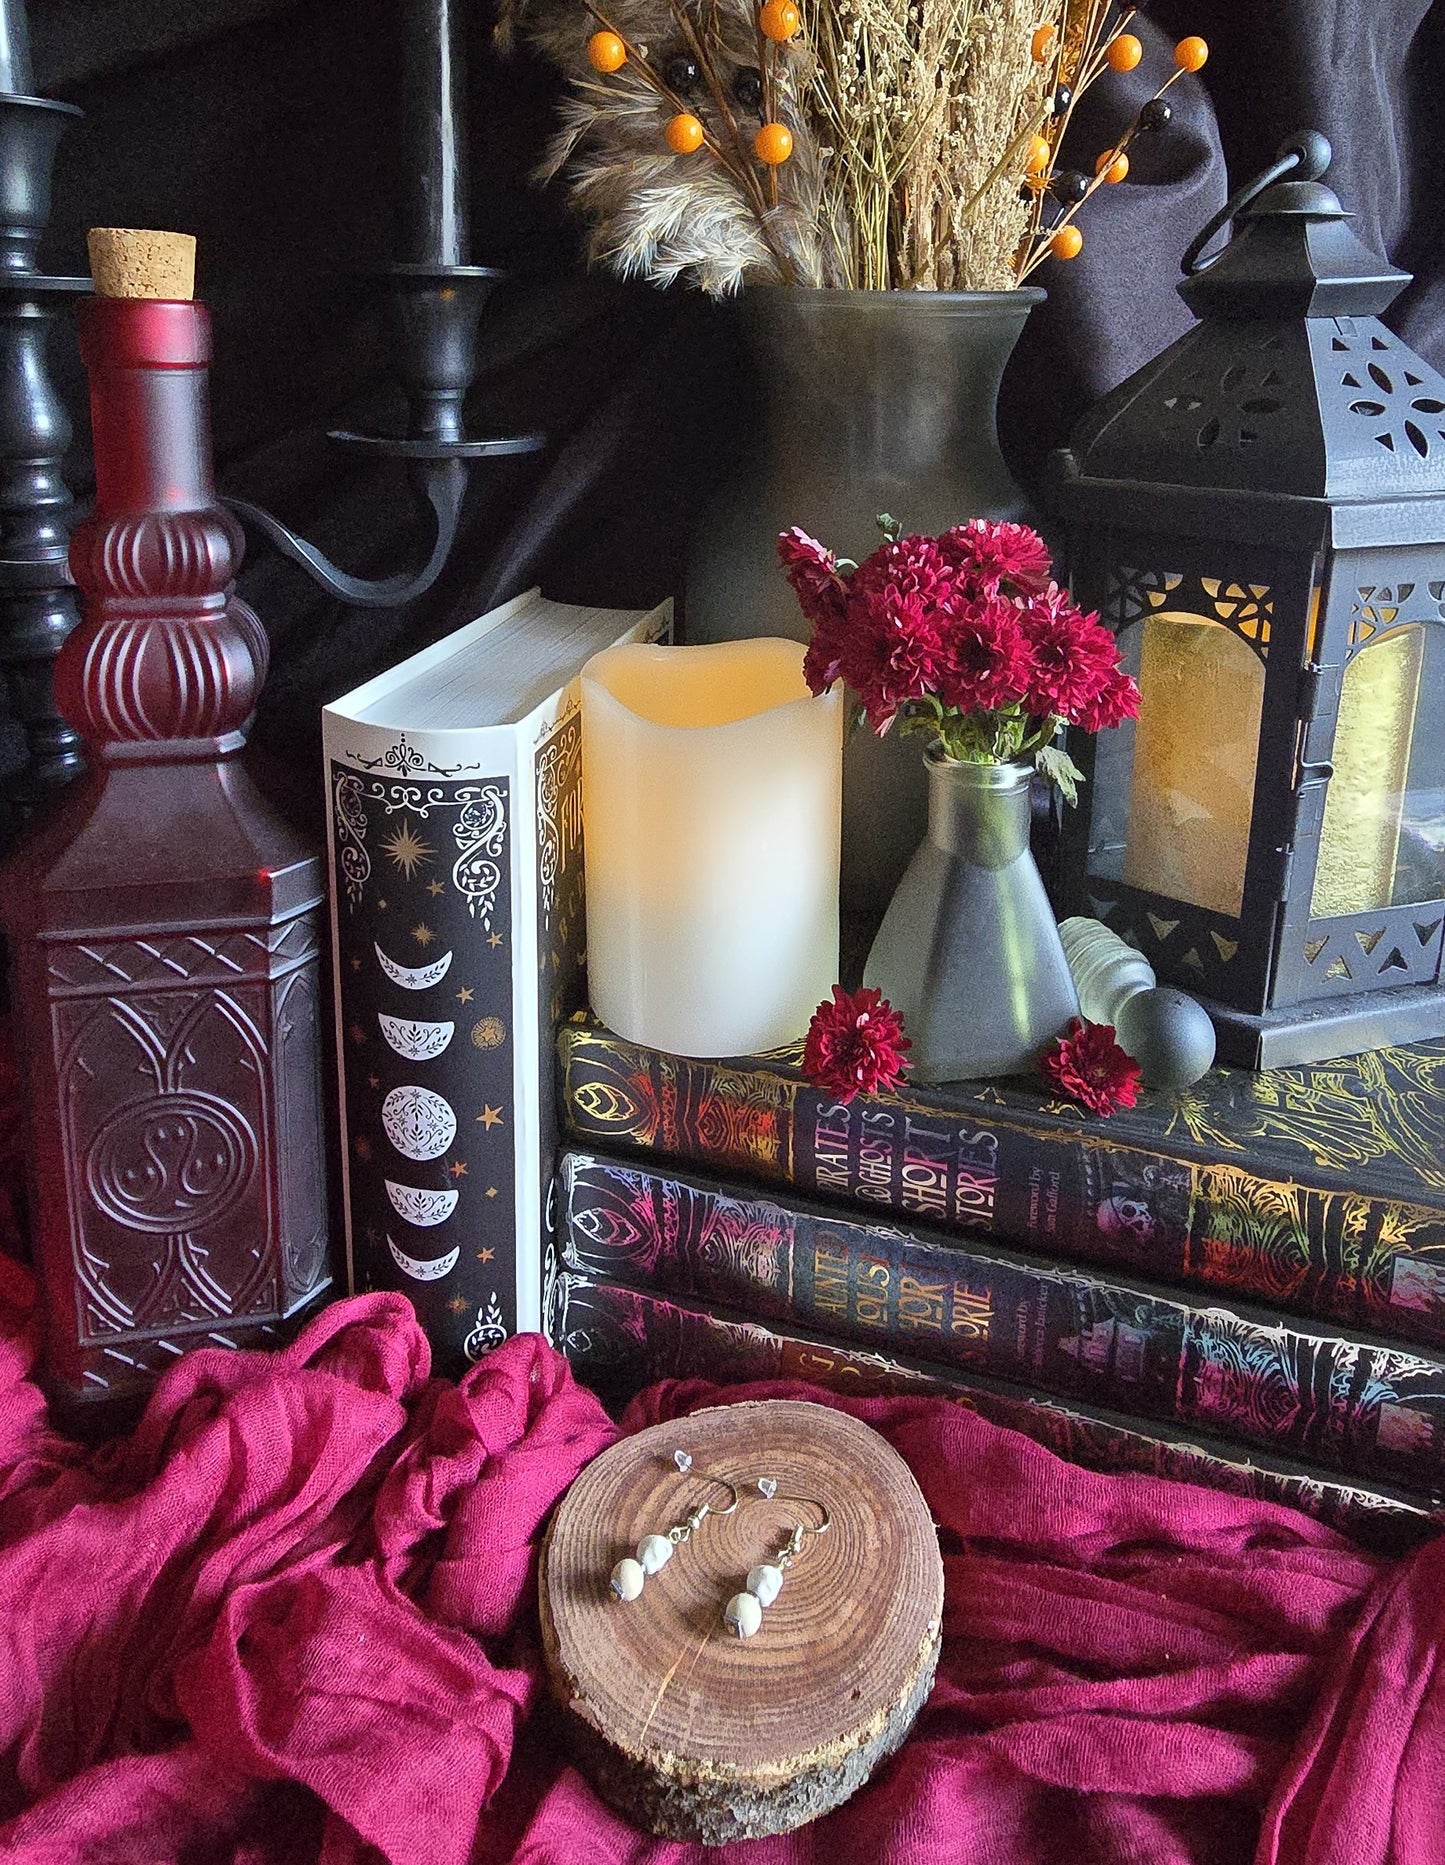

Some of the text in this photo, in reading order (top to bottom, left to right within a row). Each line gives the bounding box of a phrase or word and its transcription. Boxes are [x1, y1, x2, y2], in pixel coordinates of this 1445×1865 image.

[814, 1102, 852, 1194] PIRATES
[858, 1110, 895, 1184] GHOSTS
[901, 1116, 958, 1219] SHORT
[955, 1128, 1000, 1232] STORIES
[950, 1280, 995, 1342] ORIE
